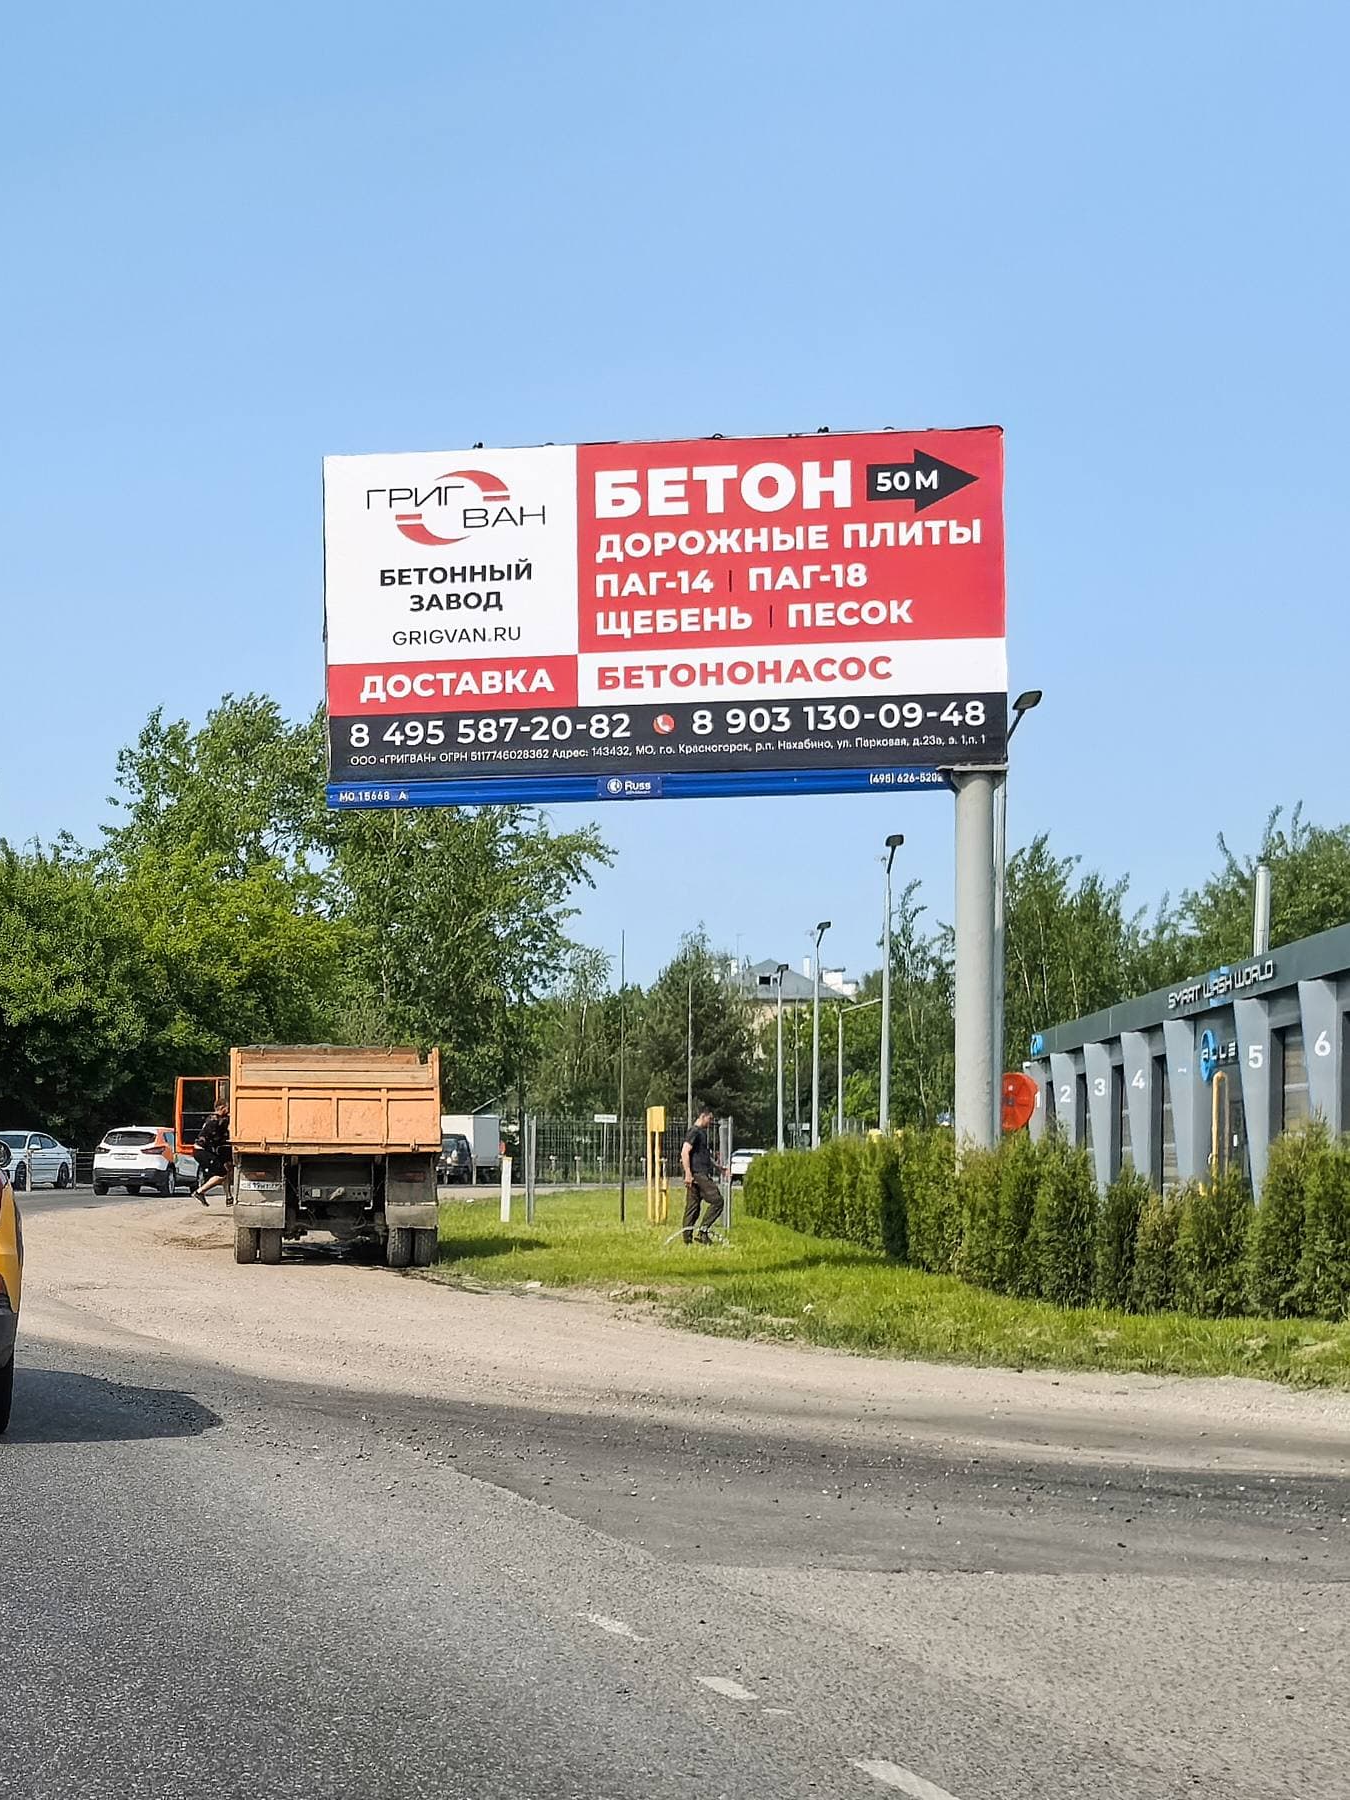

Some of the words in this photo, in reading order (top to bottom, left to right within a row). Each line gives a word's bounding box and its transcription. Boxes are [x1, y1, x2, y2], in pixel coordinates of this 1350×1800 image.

[594, 460, 851, 519] БЕТОН
[876, 471, 910, 491] 50
[915, 469, 939, 490] М
[366, 485, 465, 510] ГРИГ
[463, 505, 546, 529] ВАН
[595, 525, 829, 563] ДОРОЖНЫЕ
[843, 519, 981, 549] ПЛИТЫ
[380, 558, 532, 587] БЕТОННЫЙ
[595, 570, 714, 598] ПАГ-14
[749, 563, 868, 591] ПАГ-18
[409, 591, 503, 612] ЗАВОД
[596, 606, 753, 638] ЩЕБЕНЬ
[788, 599, 914, 628] ПЕСОК
[392, 626, 521, 646] GRIGVAN.RU
[360, 668, 554, 704] ДОСТАВКА
[597, 656, 892, 691] БЕТОНОНАСОС
[692, 710, 713, 735] 8
[725, 706, 791, 734] 903
[803, 700, 986, 731] 130-09-48
[350, 723, 370, 748] 8
[382, 720, 445, 746] 495
[457, 713, 631, 744] 587-20-82
[350, 756, 377, 766] ООО
[379, 752, 436, 764] «ГРИГВАН»
[439, 752, 468, 762] ОГРН
[470, 749, 549, 762] 5117746028362
[552, 748, 589, 760] Адрес:
[592, 746, 632, 758] 143432,
[635, 746, 656, 756] МО,
[678, 741, 751, 755] Красногорск,
[755, 742, 775, 753] р.п.
[778, 737, 834, 751] Нахабино,
[837, 740, 852, 749] ул.
[855, 736, 910, 750] Парковая,
[358, 791, 390, 801] 15668
[624, 780, 651, 791] Russ
[1202, 972, 1233, 999] WASH
[1234, 959, 1273, 989] WORLD
[1314, 1031, 1331, 1056] 6
[1248, 1045, 1263, 1069] 5
[1094, 1078, 1106, 1096] 3
[1131, 1069, 1145, 1089] 4
[1035, 1091, 1041, 1108] 1
[1060, 1085, 1071, 1103] 2
